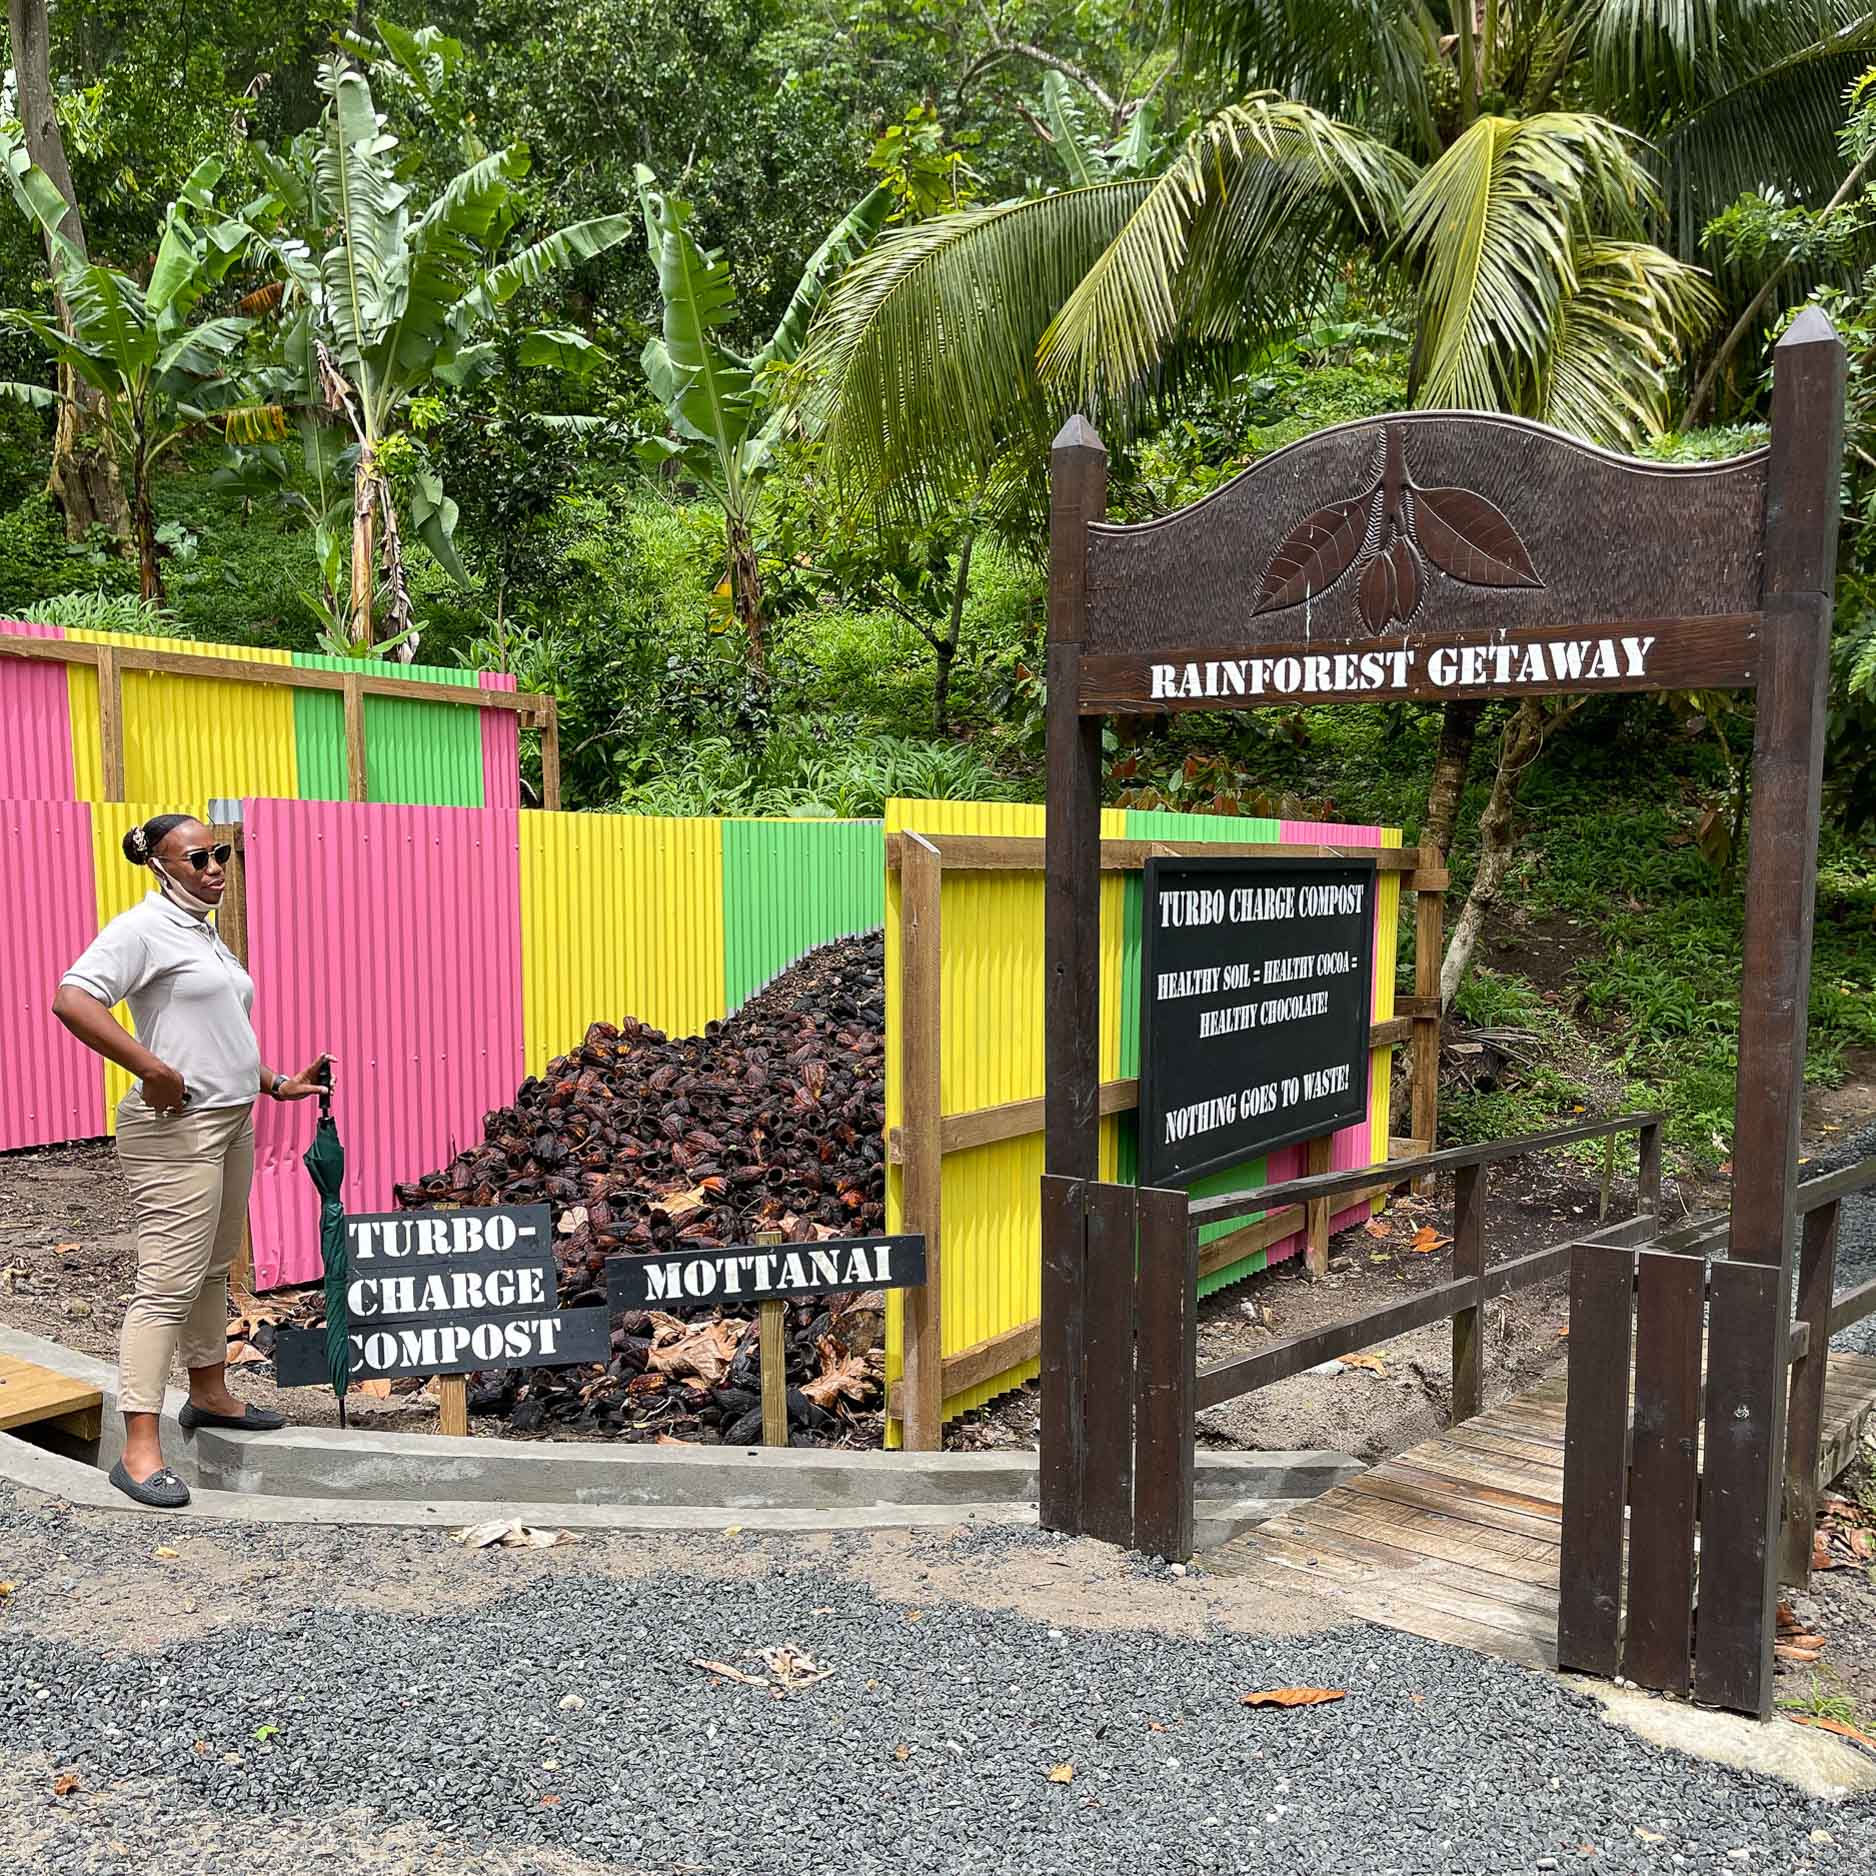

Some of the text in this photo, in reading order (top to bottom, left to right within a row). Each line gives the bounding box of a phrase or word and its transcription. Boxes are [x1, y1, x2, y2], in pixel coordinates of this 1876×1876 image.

[1150, 636, 1655, 699] RAINFOREST GETAWAY
[1159, 885, 1363, 928] TURBO CHARGE COMPOST
[1157, 968, 1220, 1000] HEALTHY
[1224, 964, 1250, 991] SOIL
[1264, 956, 1314, 984] HEALTHY
[1317, 952, 1349, 977] COCOA
[1200, 992, 1328, 1038] HEALTHY CHOCOLATE!
[1165, 1064, 1349, 1145] NOTHING GOES TO WASTE!
[348, 1211, 537, 1259] TURBO-
[348, 1267, 545, 1316] CHARGE
[642, 1246, 892, 1301] MOTTANAI
